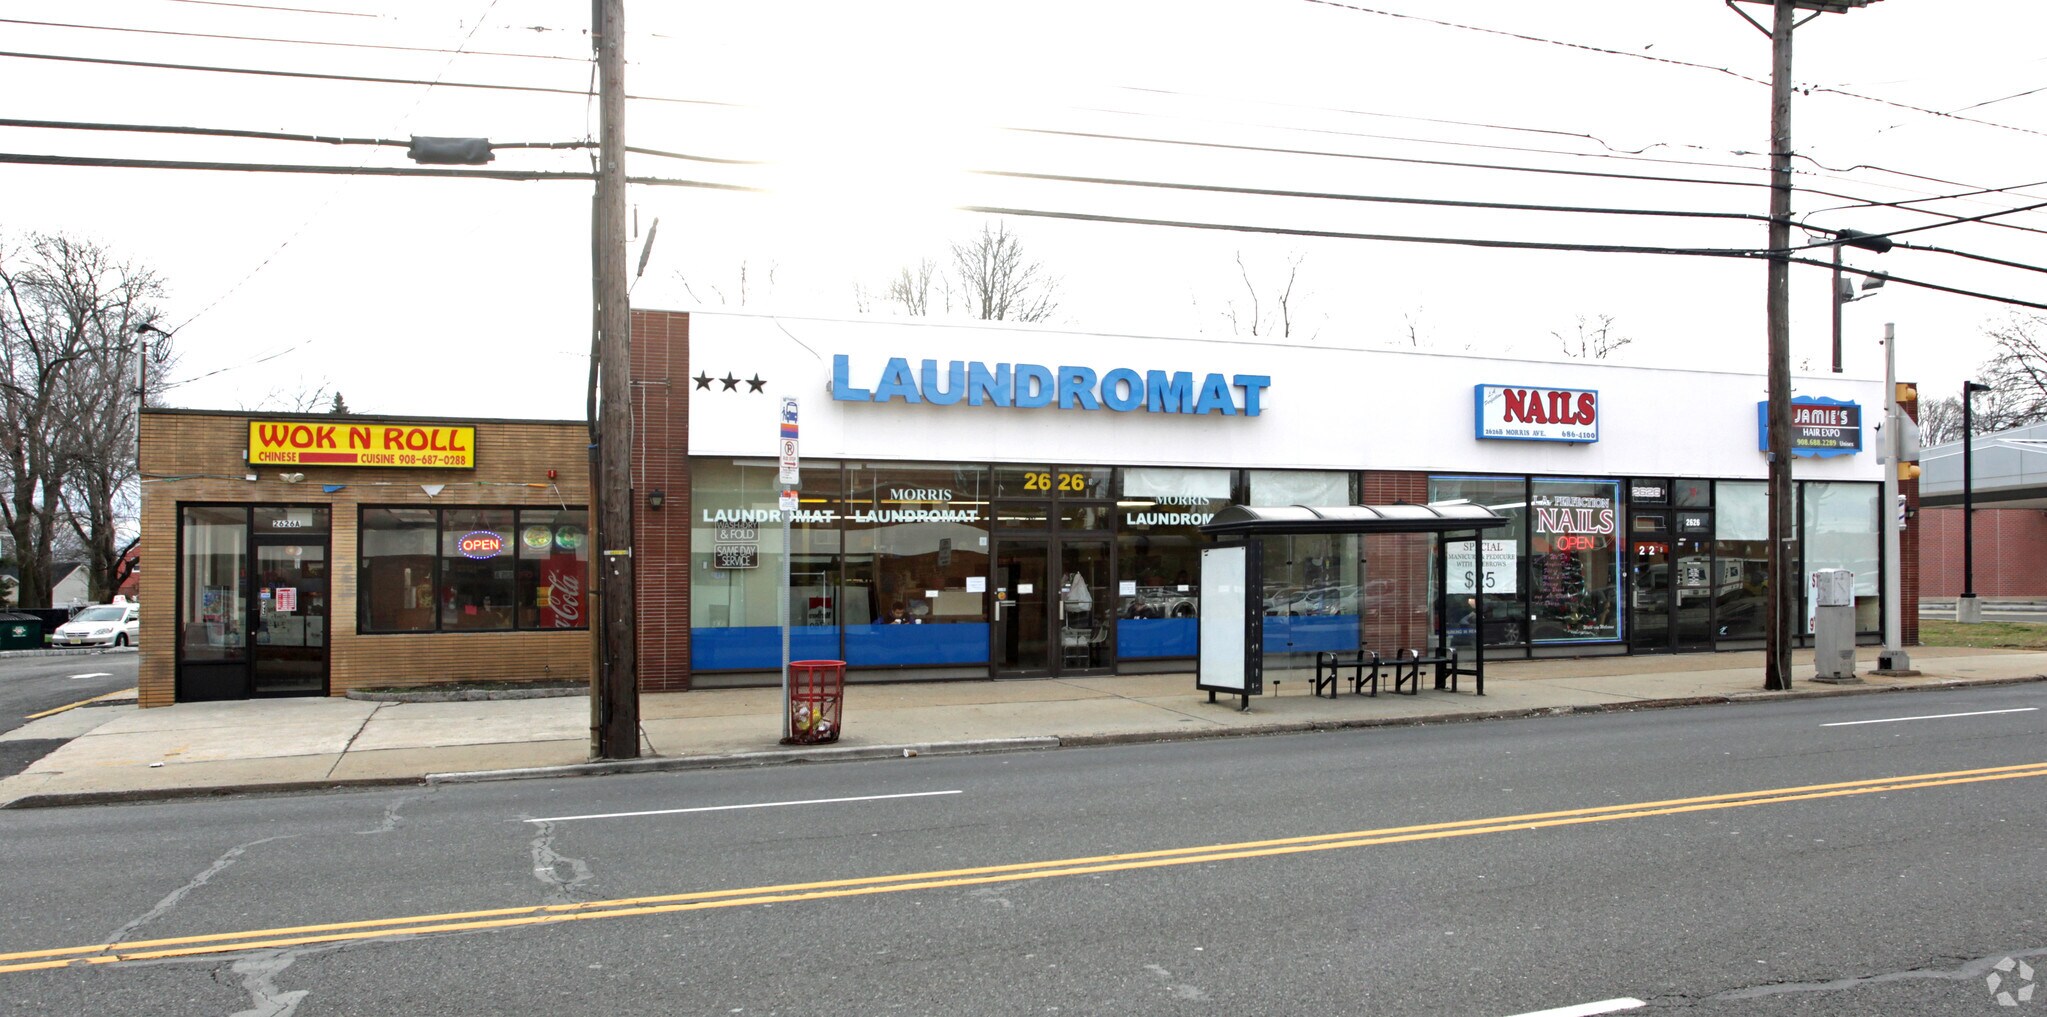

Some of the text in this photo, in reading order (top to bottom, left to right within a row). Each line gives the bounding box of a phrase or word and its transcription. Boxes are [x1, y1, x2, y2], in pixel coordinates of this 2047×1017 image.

[832, 354, 1271, 417] LAUNDROMAT
[1502, 388, 1595, 426] NAILS
[1794, 408, 1848, 425] JAMIE'S
[258, 424, 465, 452] WOK N ROLL
[1561, 430, 1595, 439] 686-4100
[1802, 427, 1840, 438] HAIR EXPO
[1796, 438, 1837, 447] 908.688.2289
[258, 451, 466, 465] CHINESE CUISINE 908-687-0288
[1023, 472, 1051, 490] 26
[1057, 473, 1085, 491] 26
[890, 488, 952, 501] MORRIS
[1155, 495, 1210, 506] MORRIS
[1554, 496, 1610, 508] PERFECTION
[855, 509, 978, 523] LAUNDROMAT
[1126, 512, 1214, 526] LAUNDROM
[1536, 508, 1614, 534] NAILS
[1685, 518, 1701, 526] 2626
[273, 520, 301, 528] 2626A
[720, 529, 755, 539] & FOLD
[463, 538, 500, 552] OPEN
[1463, 542, 1503, 552] SPCIAL
[1557, 535, 1595, 551] OPEN
[717, 546, 756, 556] SAME DAY
[722, 556, 751, 566] SERVICE
[1464, 570, 1496, 590] $5
